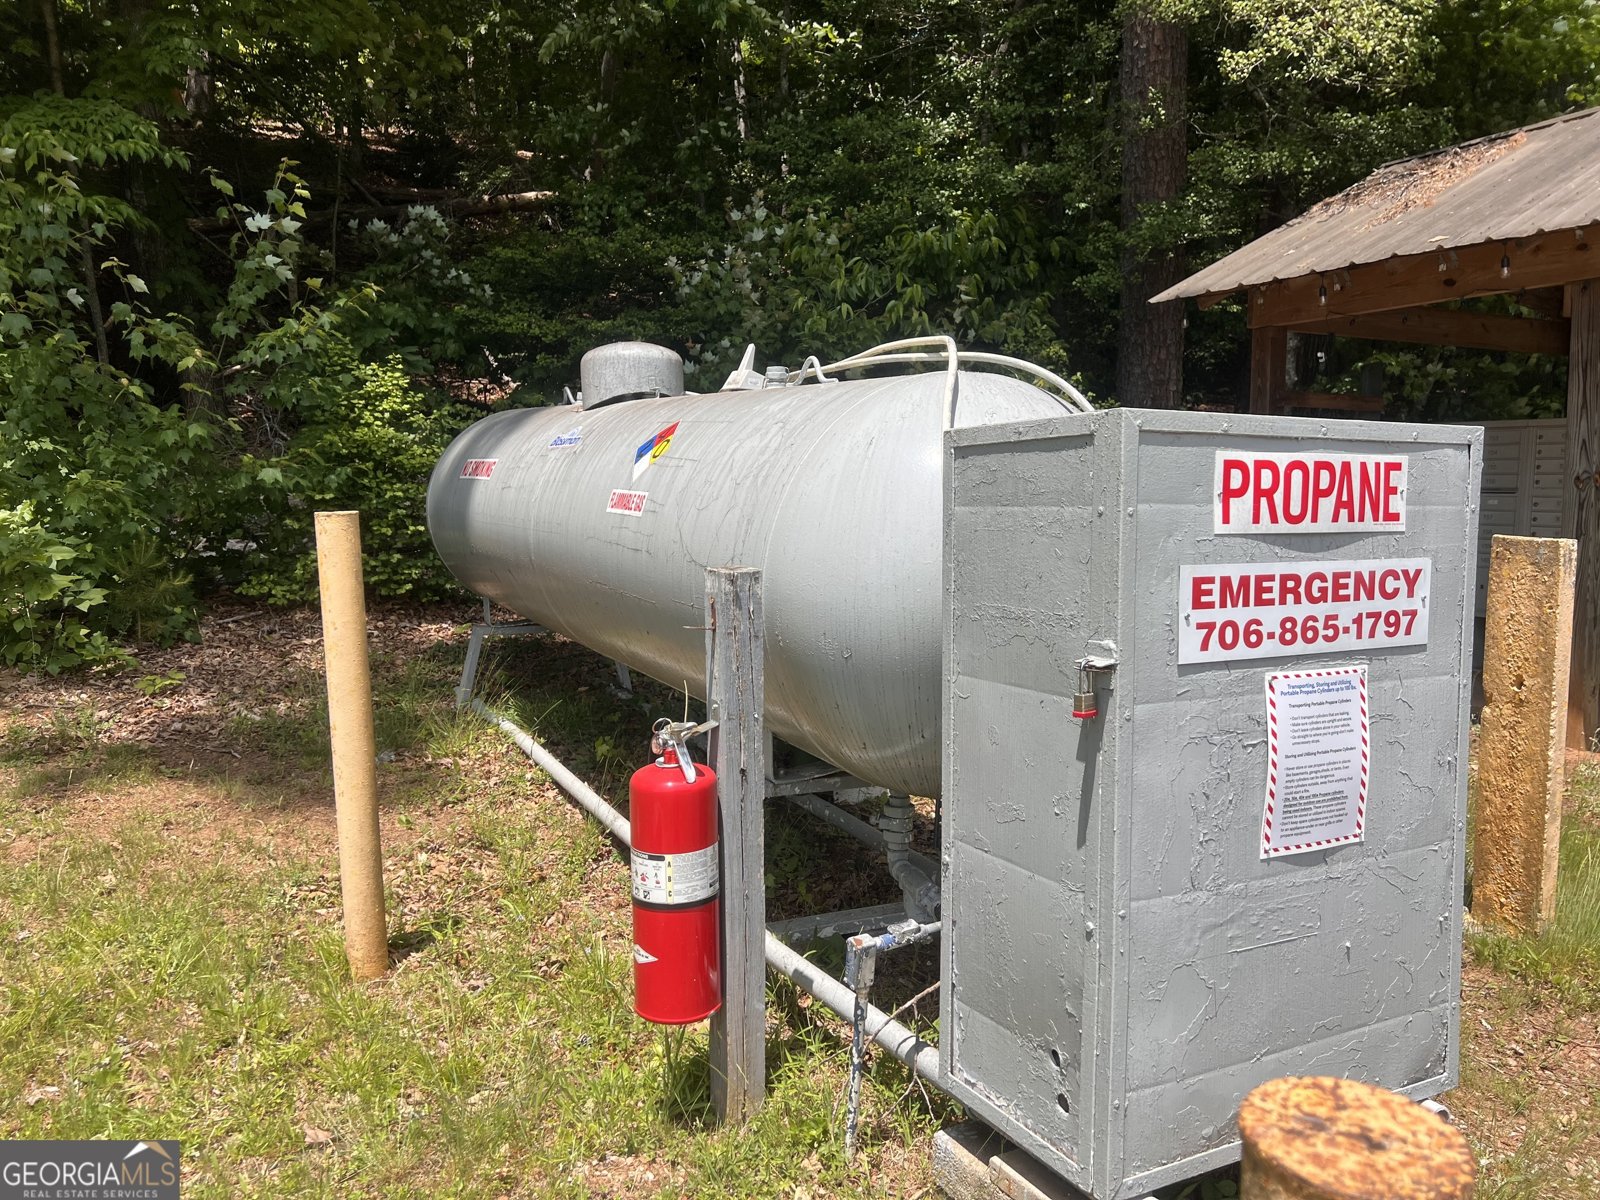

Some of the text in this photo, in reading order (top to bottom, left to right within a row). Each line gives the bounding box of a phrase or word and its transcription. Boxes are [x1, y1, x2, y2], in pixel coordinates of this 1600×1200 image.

[652, 438, 670, 458] 0
[462, 461, 496, 478] NO SMOKING
[609, 492, 646, 512] FLAMMABLE GAS
[1221, 458, 1402, 525] PROPANE
[1191, 568, 1423, 610] EMERGENCY
[1196, 609, 1419, 652] 706-865-1797
